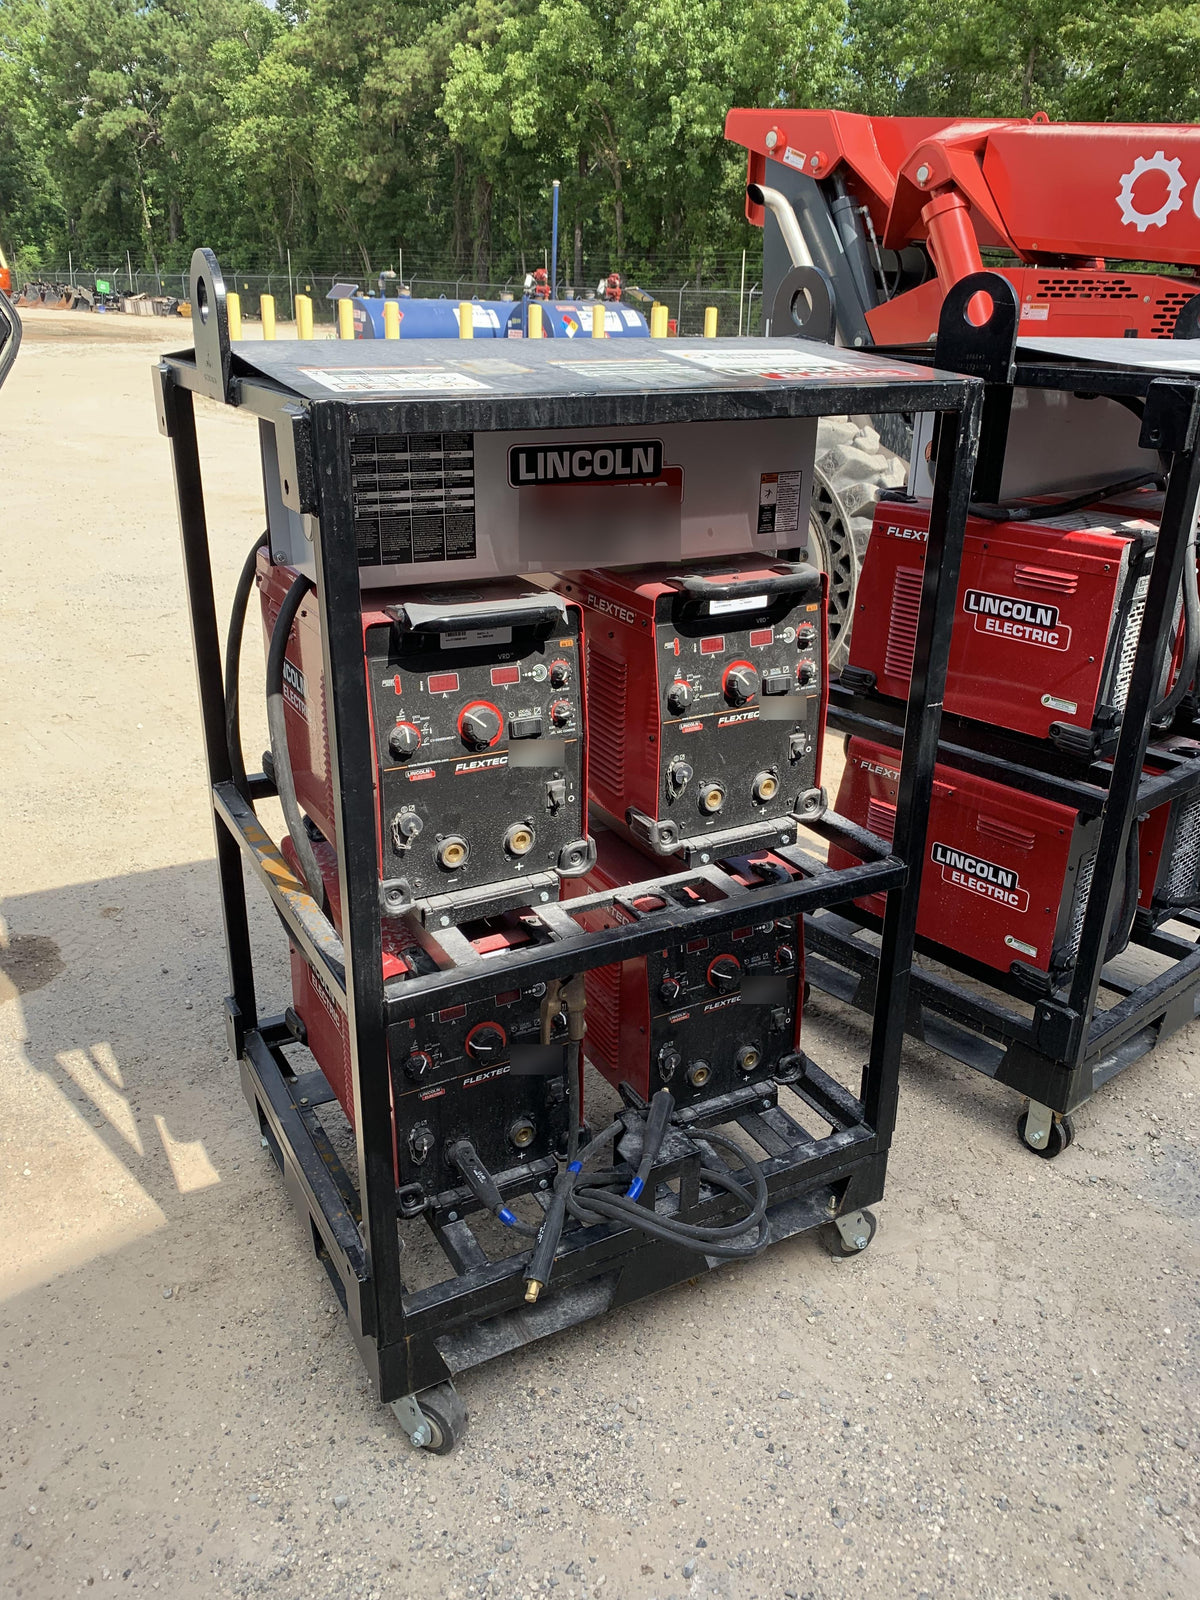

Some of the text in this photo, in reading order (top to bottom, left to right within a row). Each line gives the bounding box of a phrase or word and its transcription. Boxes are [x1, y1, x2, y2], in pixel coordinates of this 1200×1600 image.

[518, 447, 654, 480] LINCOLN
[887, 526, 929, 541] FLEXT
[587, 594, 635, 624] FLEXTEC
[968, 594, 1053, 625] LINCOLN
[985, 618, 1059, 645] ELECTRIC
[718, 711, 759, 724] FLEXTEC
[455, 756, 508, 772] FLEXTEC
[859, 760, 900, 780] FLEXT
[936, 846, 1013, 889] LINCOLN
[951, 870, 1019, 906] ELECTRIC
[704, 995, 741, 1012] FLEXTEC
[463, 1065, 511, 1086] FLEXTEC
